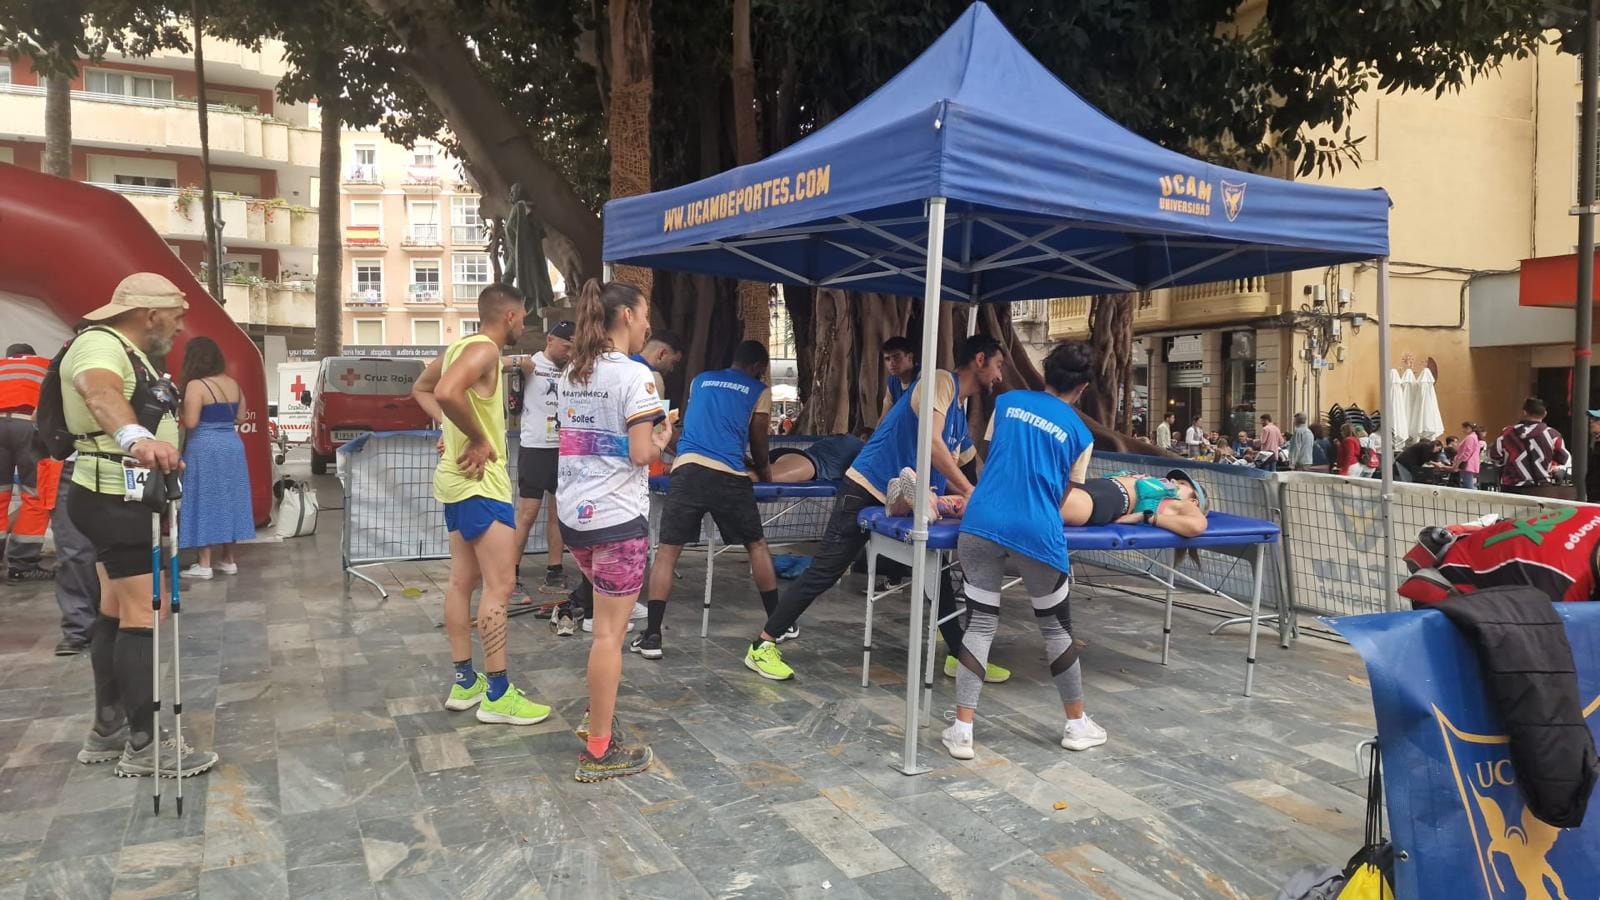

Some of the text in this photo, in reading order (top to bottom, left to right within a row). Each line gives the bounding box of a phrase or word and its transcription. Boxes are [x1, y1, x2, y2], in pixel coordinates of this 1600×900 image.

[1159, 174, 1212, 203] UCAM
[1159, 197, 1211, 216] UNIVERSIDAD
[364, 374, 414, 387] Cruz Roja
[1005, 407, 1068, 444] FISIOTERAPIA
[1475, 759, 1515, 788] UC
